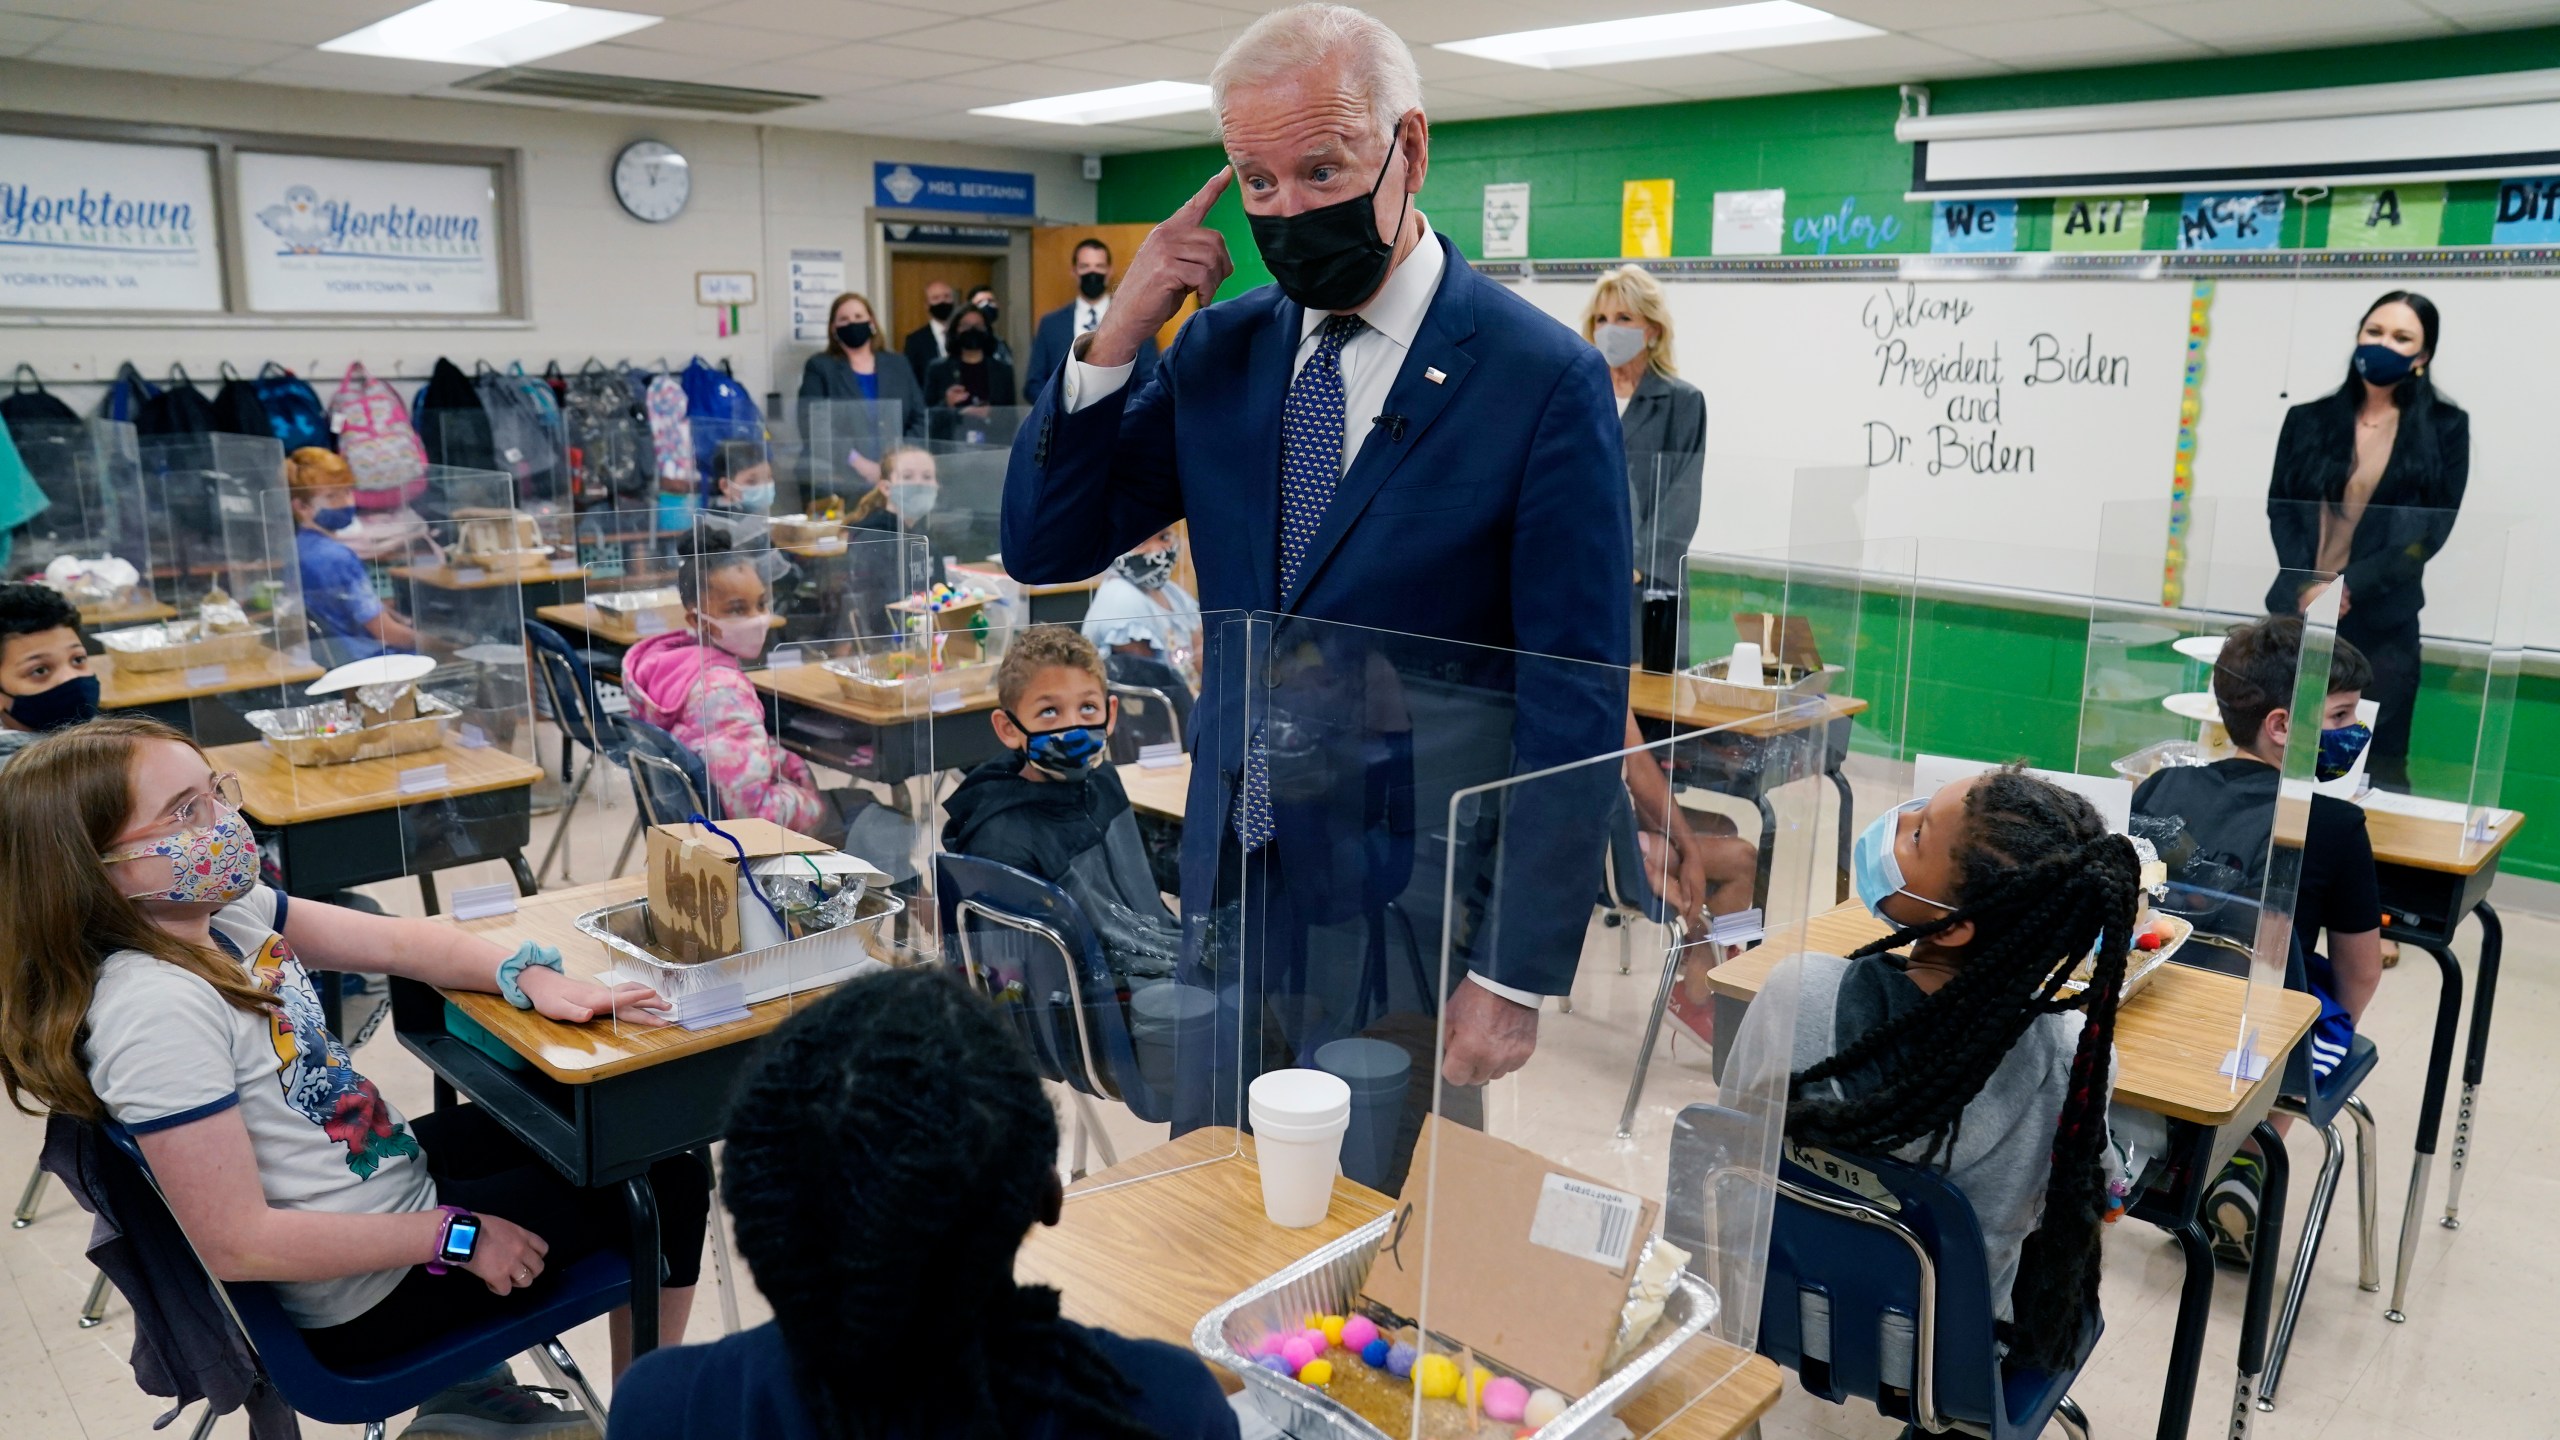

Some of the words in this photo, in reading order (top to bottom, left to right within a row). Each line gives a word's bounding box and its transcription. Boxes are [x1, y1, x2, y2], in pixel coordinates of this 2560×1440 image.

[0, 182, 195, 237] Yorktown
[323, 198, 481, 248] Yorktown
[1792, 196, 1901, 255] explore
[1945, 204, 1996, 237] We
[2063, 198, 2127, 236] All
[2365, 188, 2402, 227] A
[1863, 282, 1973, 340] Welcome
[1875, 338, 2004, 399] President
[2025, 332, 2129, 387] Biden
[1947, 388, 2003, 425] and
[1863, 421, 1914, 468] Dr.
[1928, 423, 2035, 476] Biden
